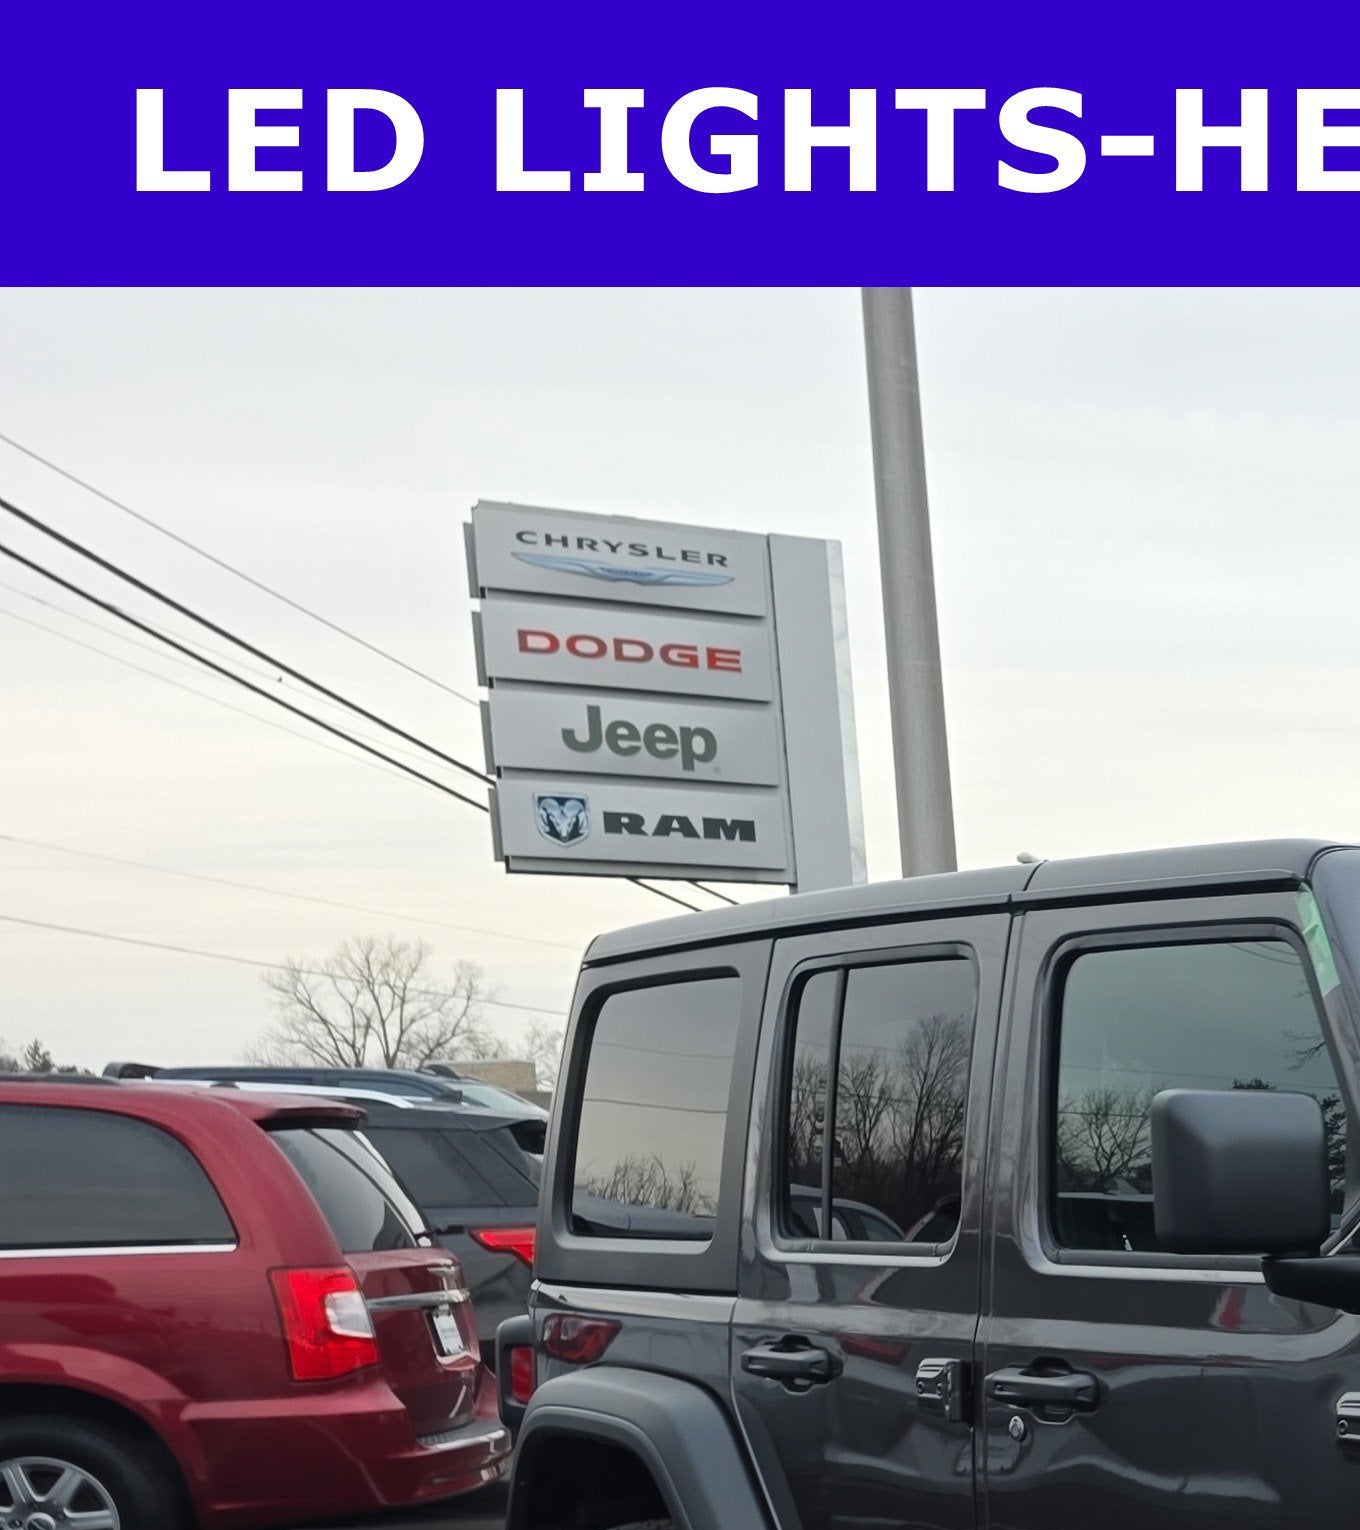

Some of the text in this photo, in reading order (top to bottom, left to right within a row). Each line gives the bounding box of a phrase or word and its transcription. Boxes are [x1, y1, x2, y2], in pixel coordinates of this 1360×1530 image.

[515, 530, 729, 568] CHRYSLER
[517, 627, 743, 674] DODGE
[561, 704, 718, 771] Jeep
[602, 810, 757, 842] RAM
